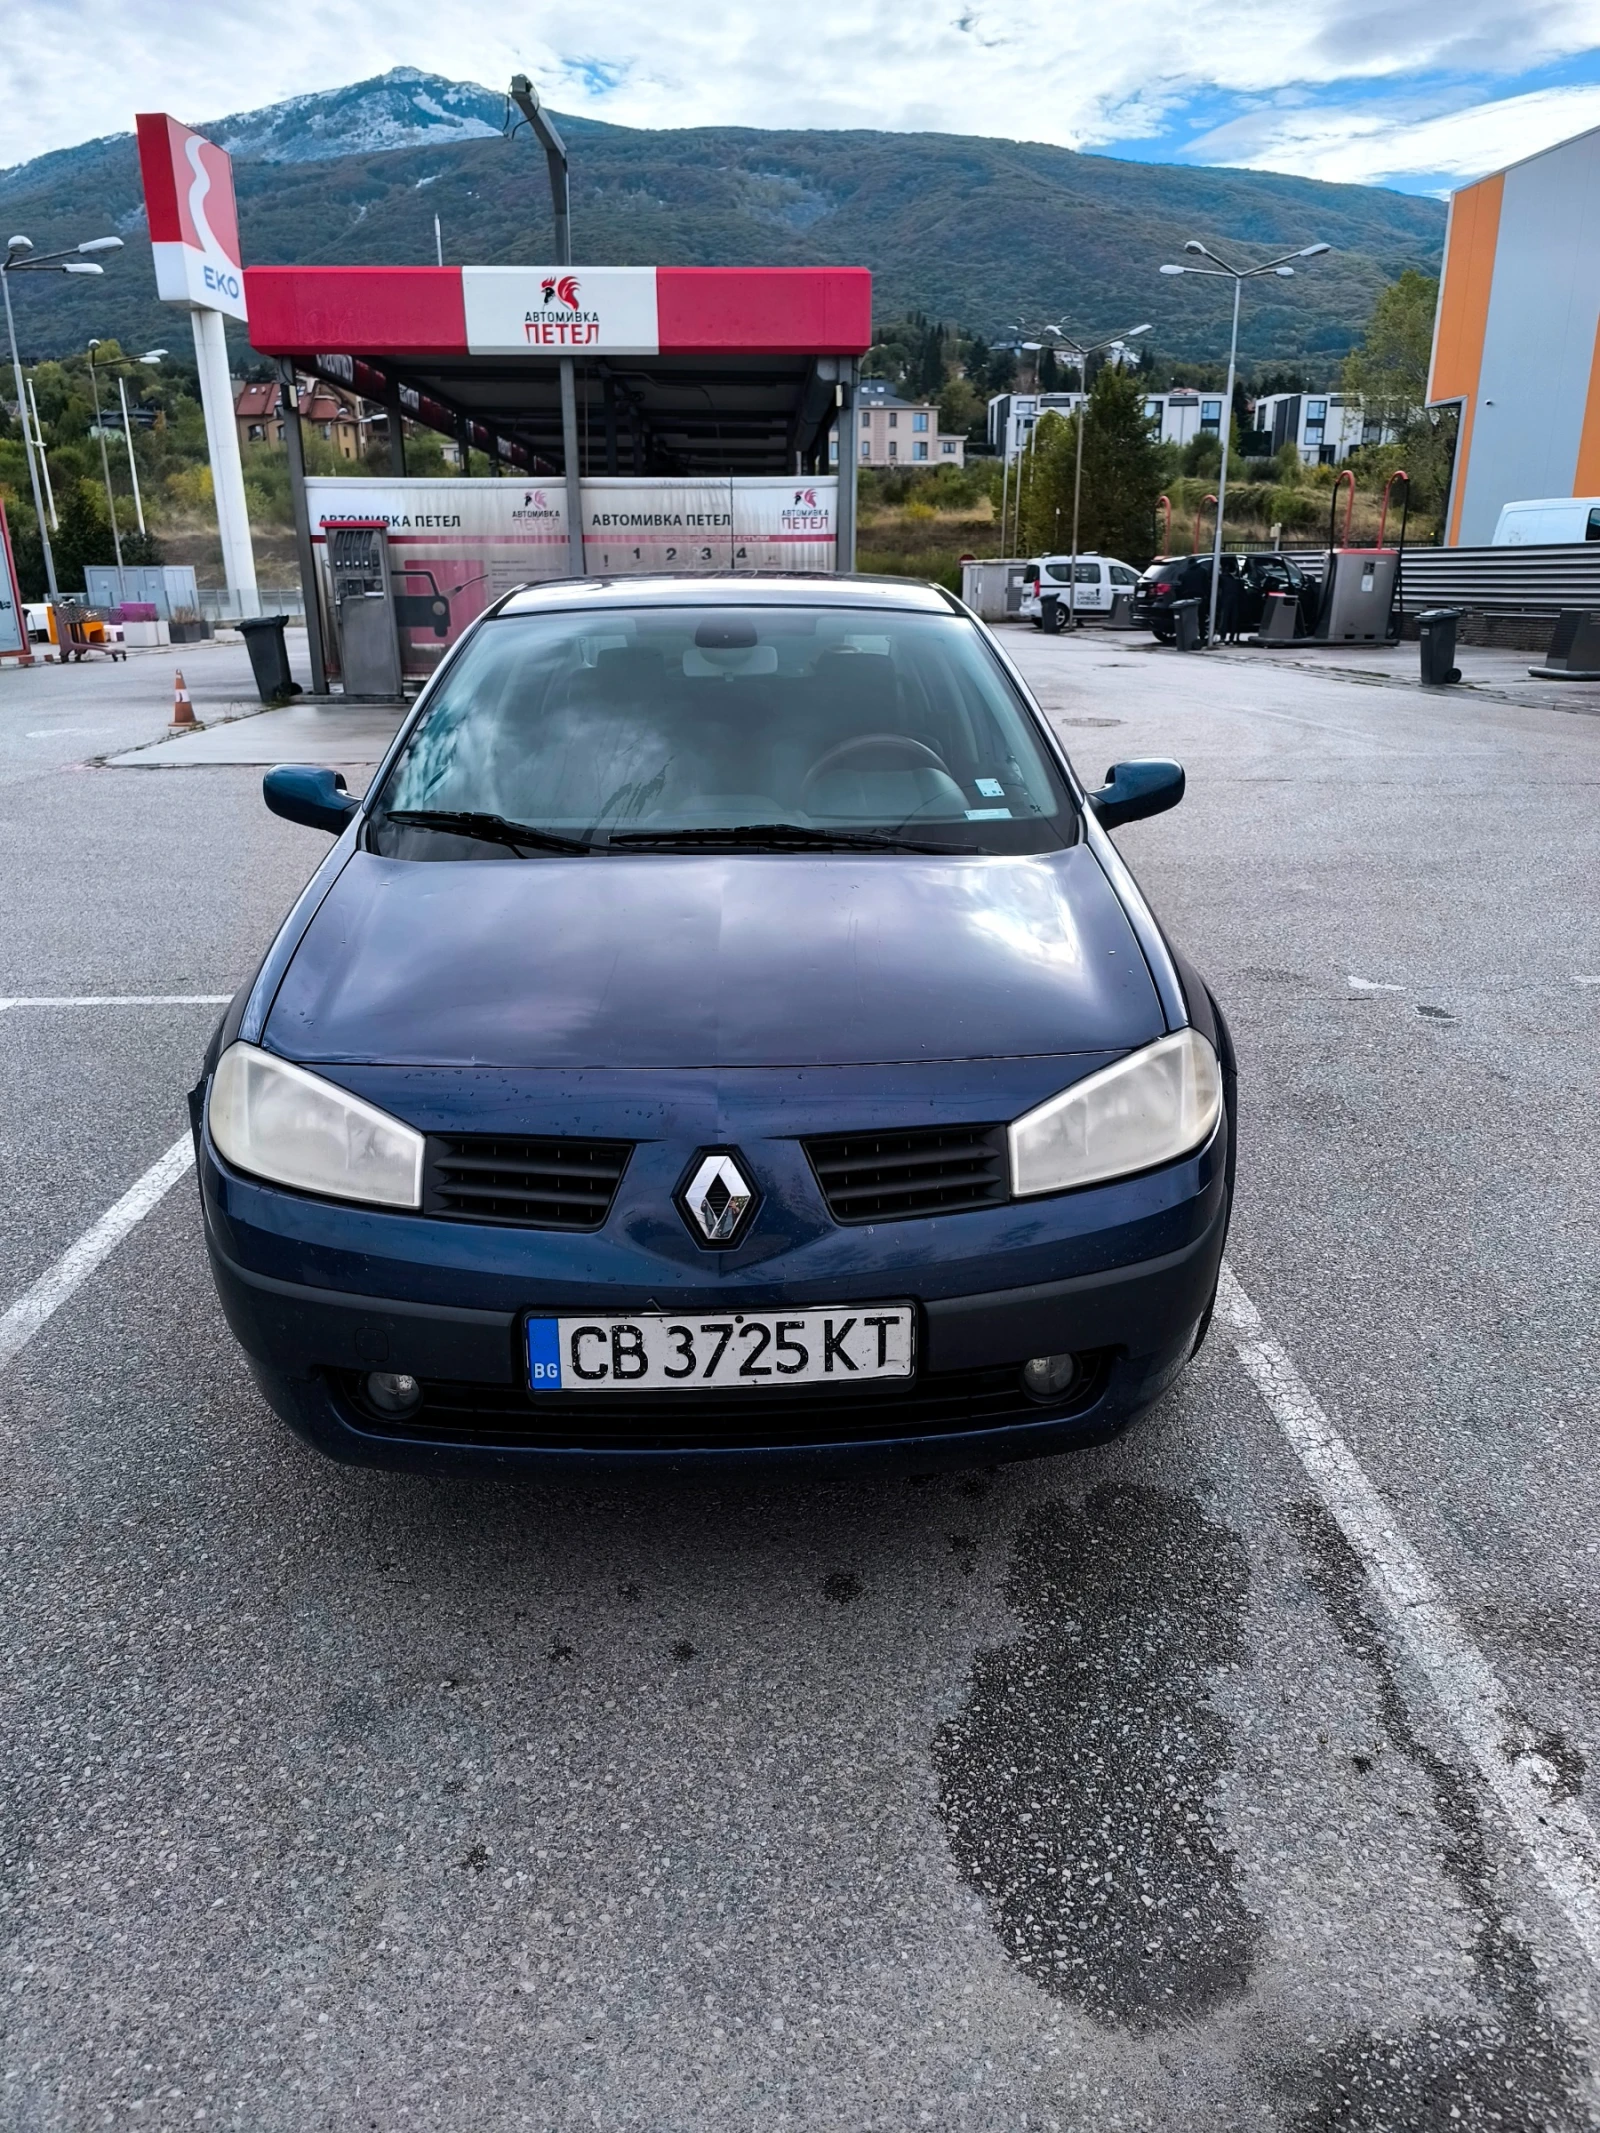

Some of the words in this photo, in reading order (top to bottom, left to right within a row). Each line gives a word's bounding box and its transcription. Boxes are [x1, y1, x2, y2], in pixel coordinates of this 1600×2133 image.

[203, 265, 239, 299] EKO
[525, 312, 600, 322] АВТОМИВКА
[525, 324, 600, 344] ПЕТЕЛ
[512, 510, 560, 518] АВТОМИВКА
[592, 514, 683, 526] АВТОМИВКА
[686, 514, 731, 526] ПЕТЕЛ
[415, 515, 461, 527] ПЕТЕЛ
[781, 517, 829, 530] ПЕТЕЛ
[633, 548, 641, 559] 1
[666, 548, 677, 560] 2
[701, 548, 712, 560] 3
[736, 547, 747, 559] 4
[571, 1324, 648, 1380] CB
[663, 1321, 809, 1378] 3725
[824, 1316, 900, 1373] KT
[534, 1363, 558, 1379] BG
